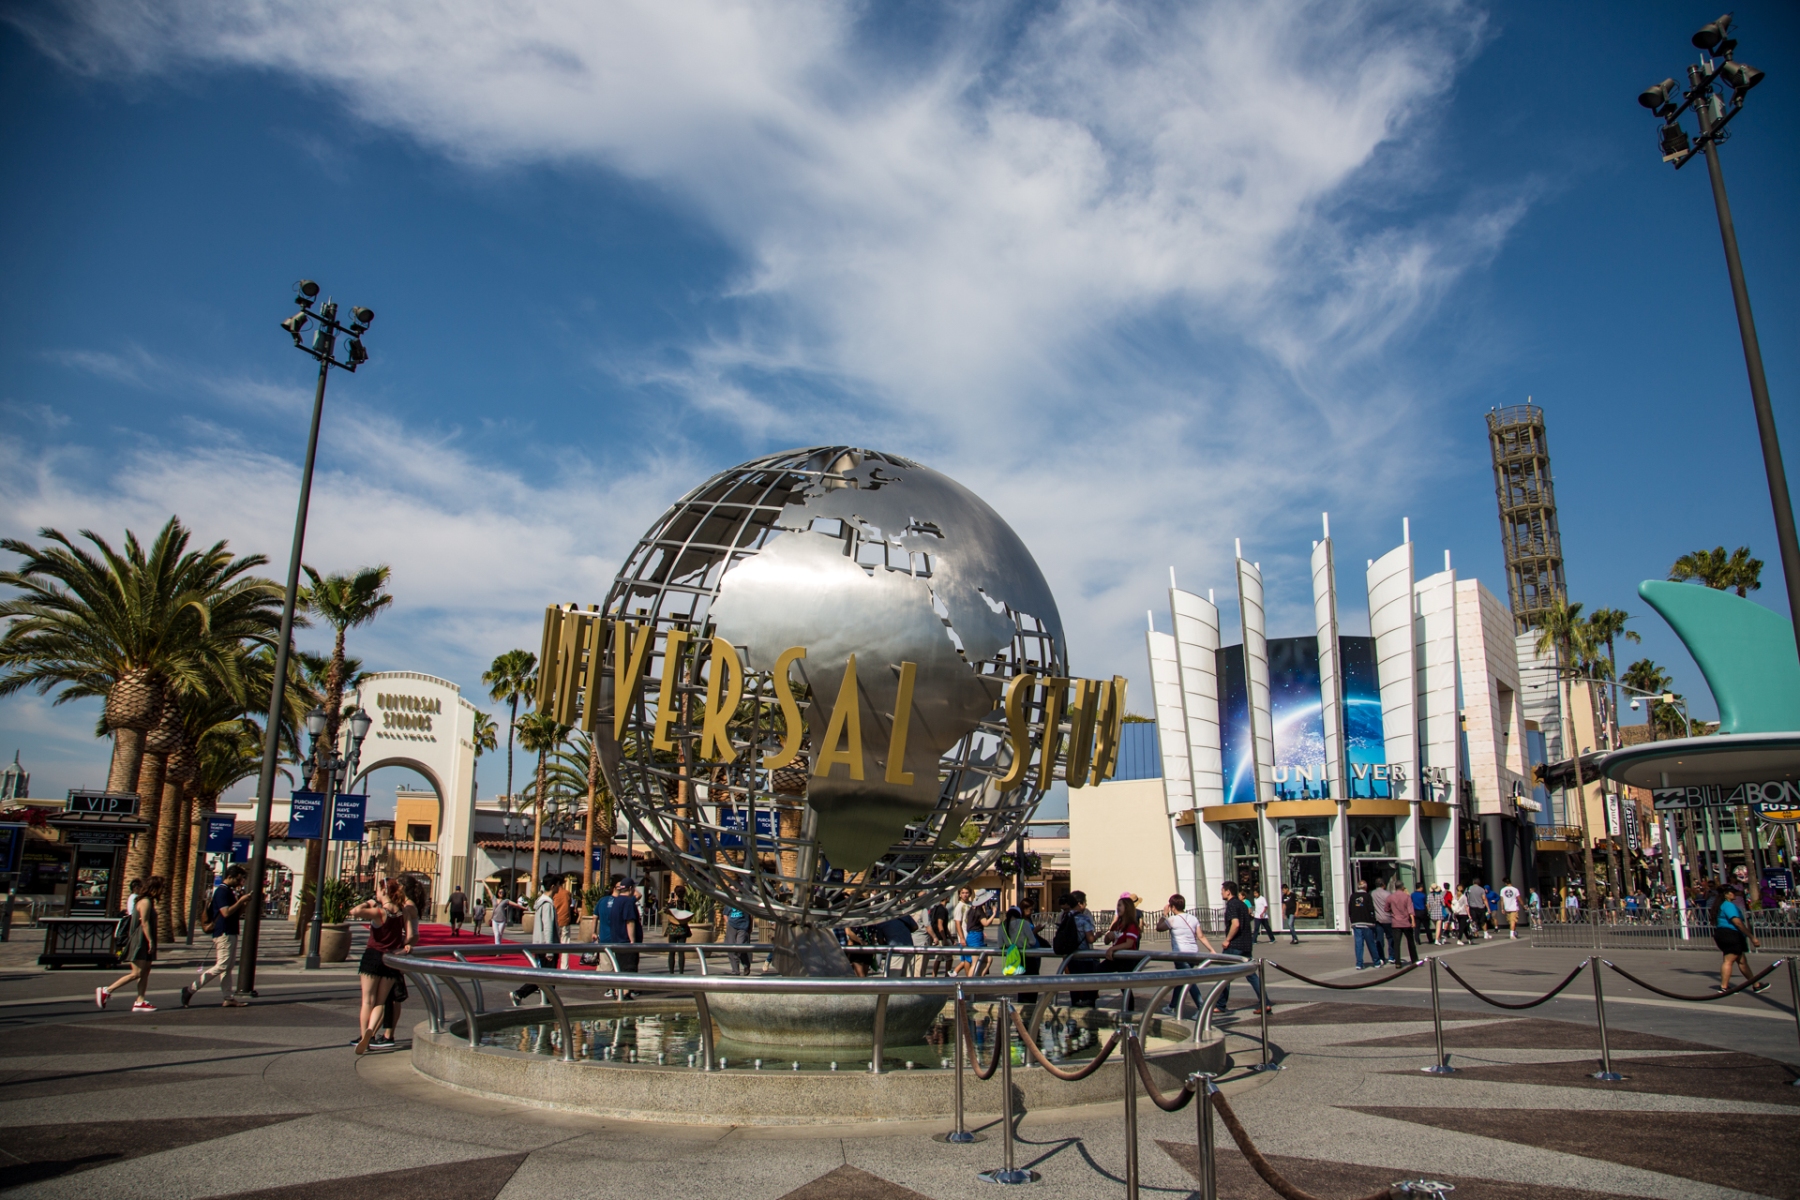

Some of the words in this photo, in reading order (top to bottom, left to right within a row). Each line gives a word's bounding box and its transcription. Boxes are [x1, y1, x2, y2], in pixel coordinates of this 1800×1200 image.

[536, 606, 917, 786] UNIVERSAL
[383, 711, 432, 732] STUDIOS
[87, 798, 118, 812] VIP
